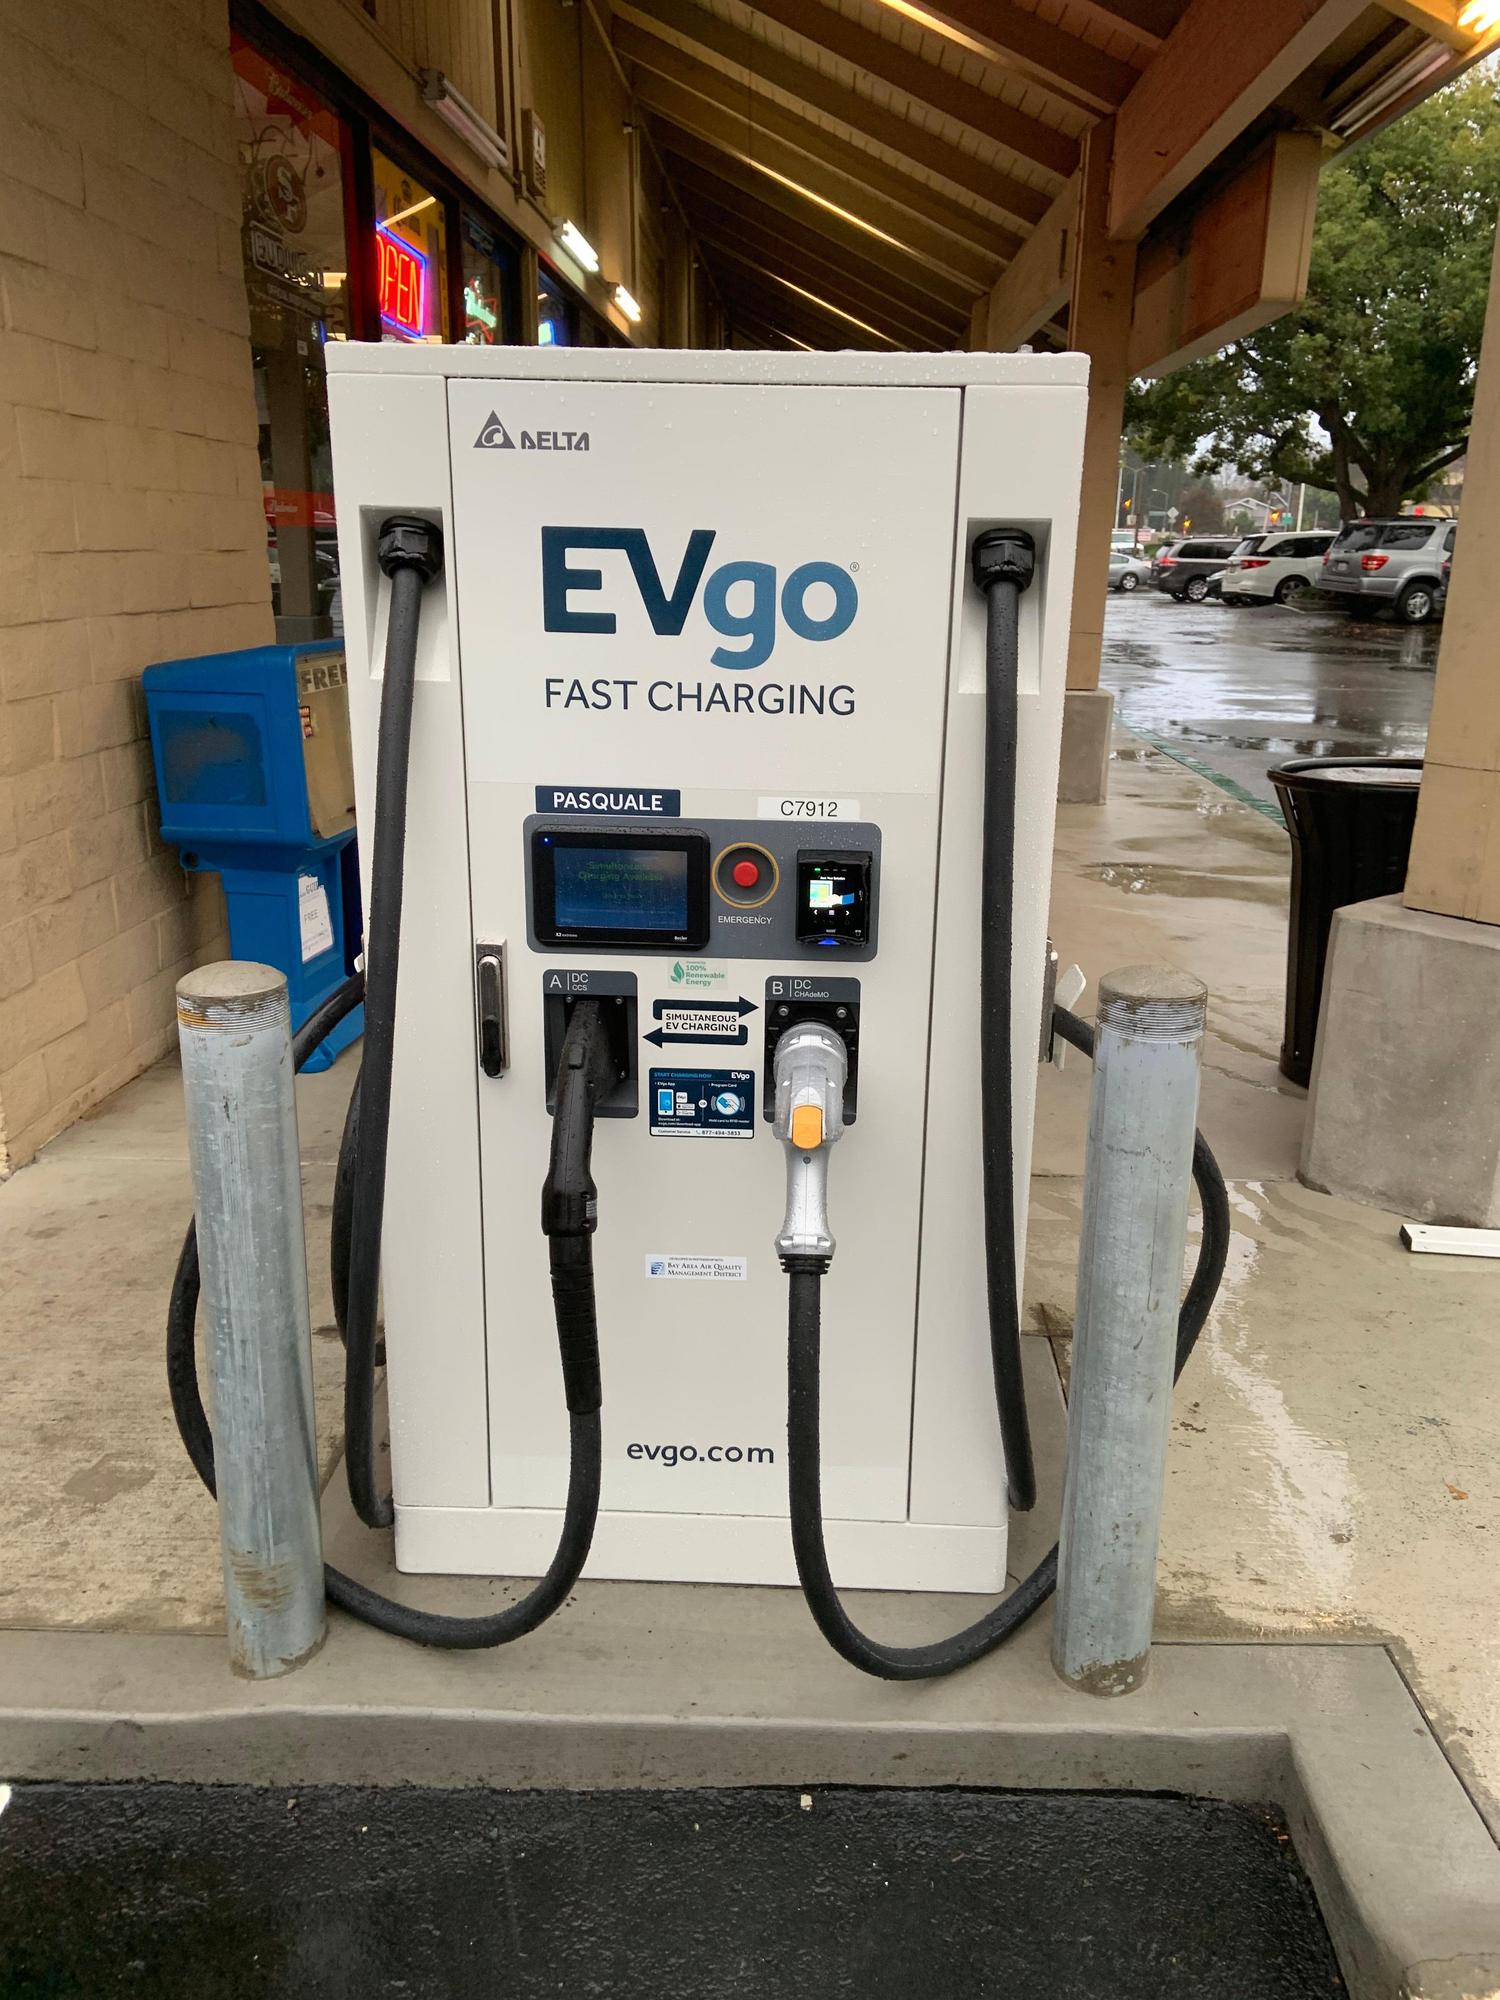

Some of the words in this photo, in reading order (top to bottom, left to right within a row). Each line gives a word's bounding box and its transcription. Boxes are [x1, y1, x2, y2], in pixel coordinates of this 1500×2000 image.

[521, 431, 590, 451] DELTA
[541, 526, 858, 670] EVgo
[545, 679, 638, 710] FAST
[648, 680, 856, 716] CHARGING
[553, 791, 663, 811] PASQUALE
[780, 800, 838, 817] C7912
[718, 915, 773, 925] EMERGENCY
[549, 974, 562, 988] A
[571, 972, 589, 983] DC
[685, 979, 712, 987] Energy
[794, 979, 812, 990] DC
[772, 981, 784, 995] B
[665, 1012, 737, 1023] SIMULTANEOUS
[665, 1021, 680, 1030] EV
[681, 1022, 737, 1032] CHARGING
[731, 1072, 750, 1080] EVgo
[626, 1443, 775, 1467] evgo.com
